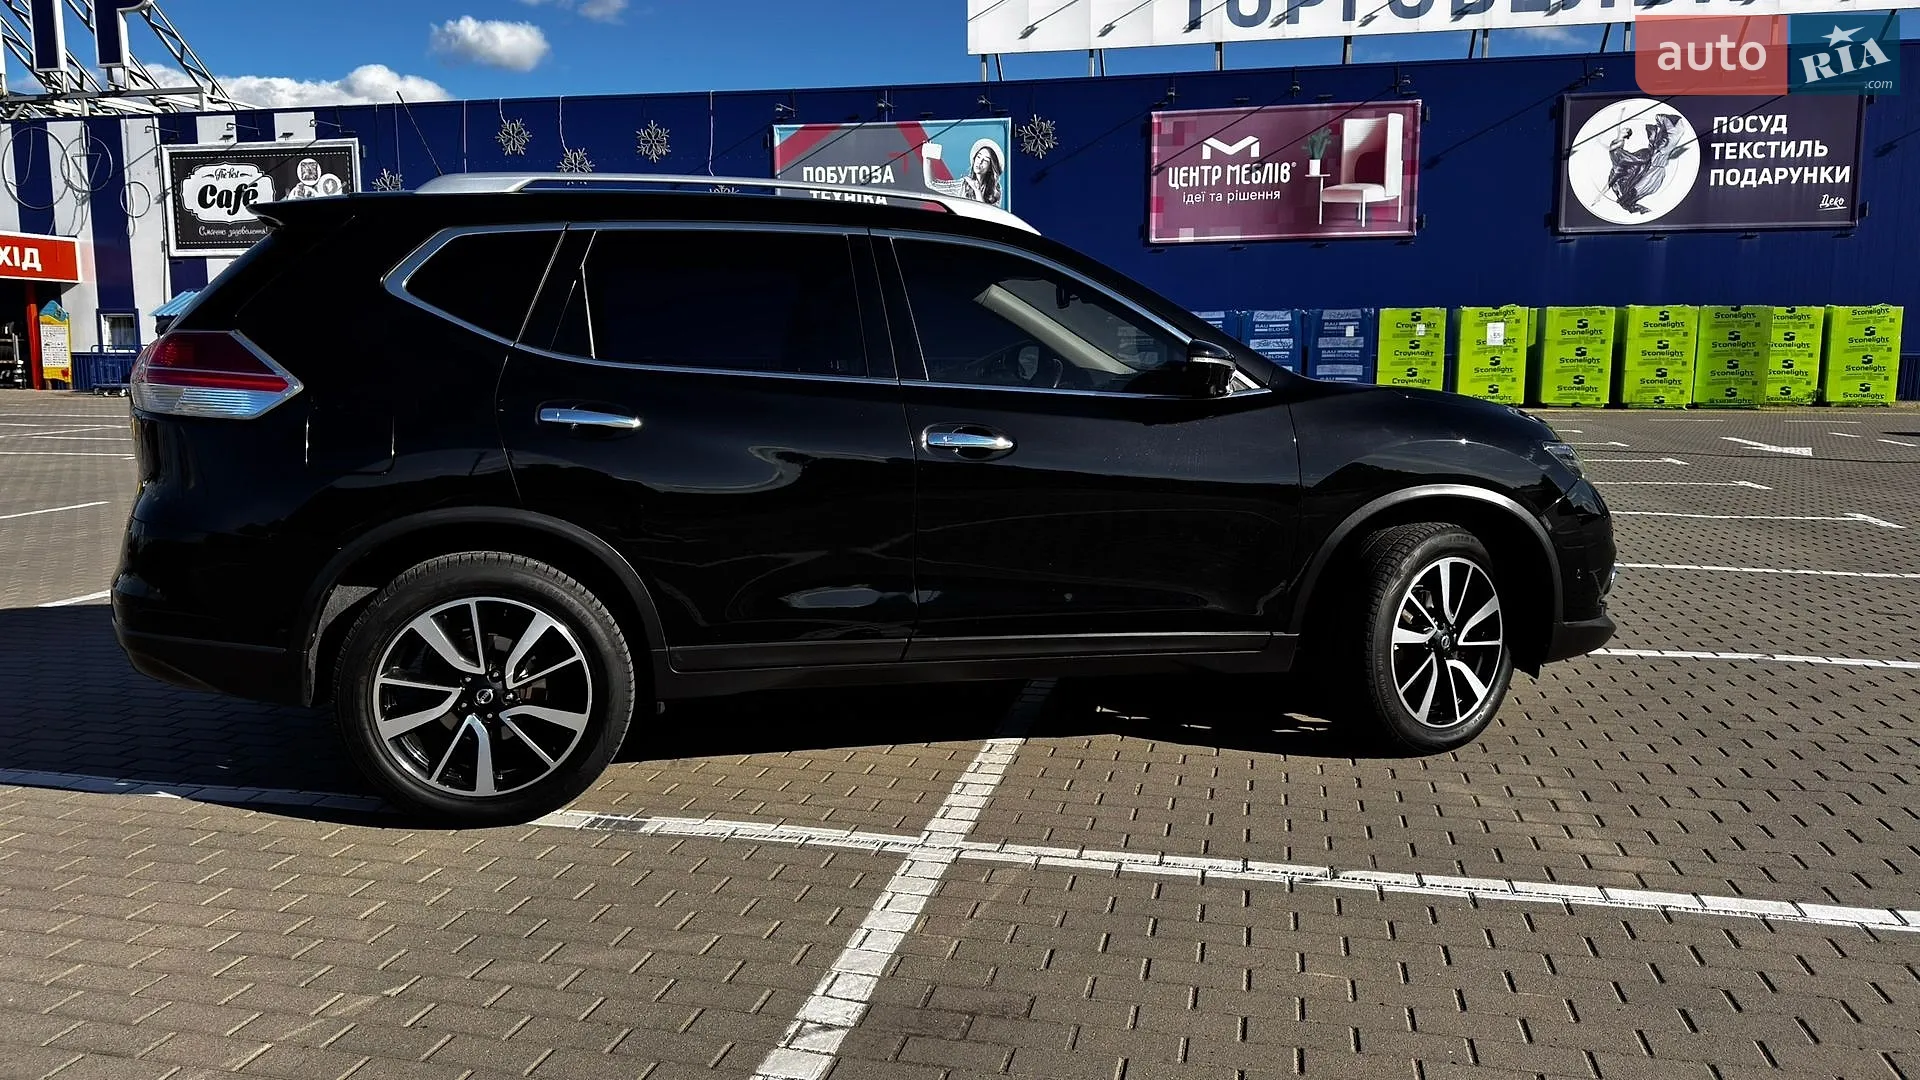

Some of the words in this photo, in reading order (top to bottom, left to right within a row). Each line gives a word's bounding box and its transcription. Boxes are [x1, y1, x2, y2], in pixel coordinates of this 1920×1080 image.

[1712, 114, 1788, 135] ПОСУД
[1710, 139, 1829, 160] ТЕКСТИЛЬ
[802, 164, 895, 184] ПОБУТОВА
[1167, 165, 1222, 190] ЦЕНТР
[1709, 165, 1851, 188] ПОДАРУНКИ
[197, 183, 259, 216] Café
[1183, 191, 1206, 205] ідеї
[1209, 193, 1223, 202] та
[1227, 189, 1281, 204] рішення
[1819, 194, 1845, 208] Деко
